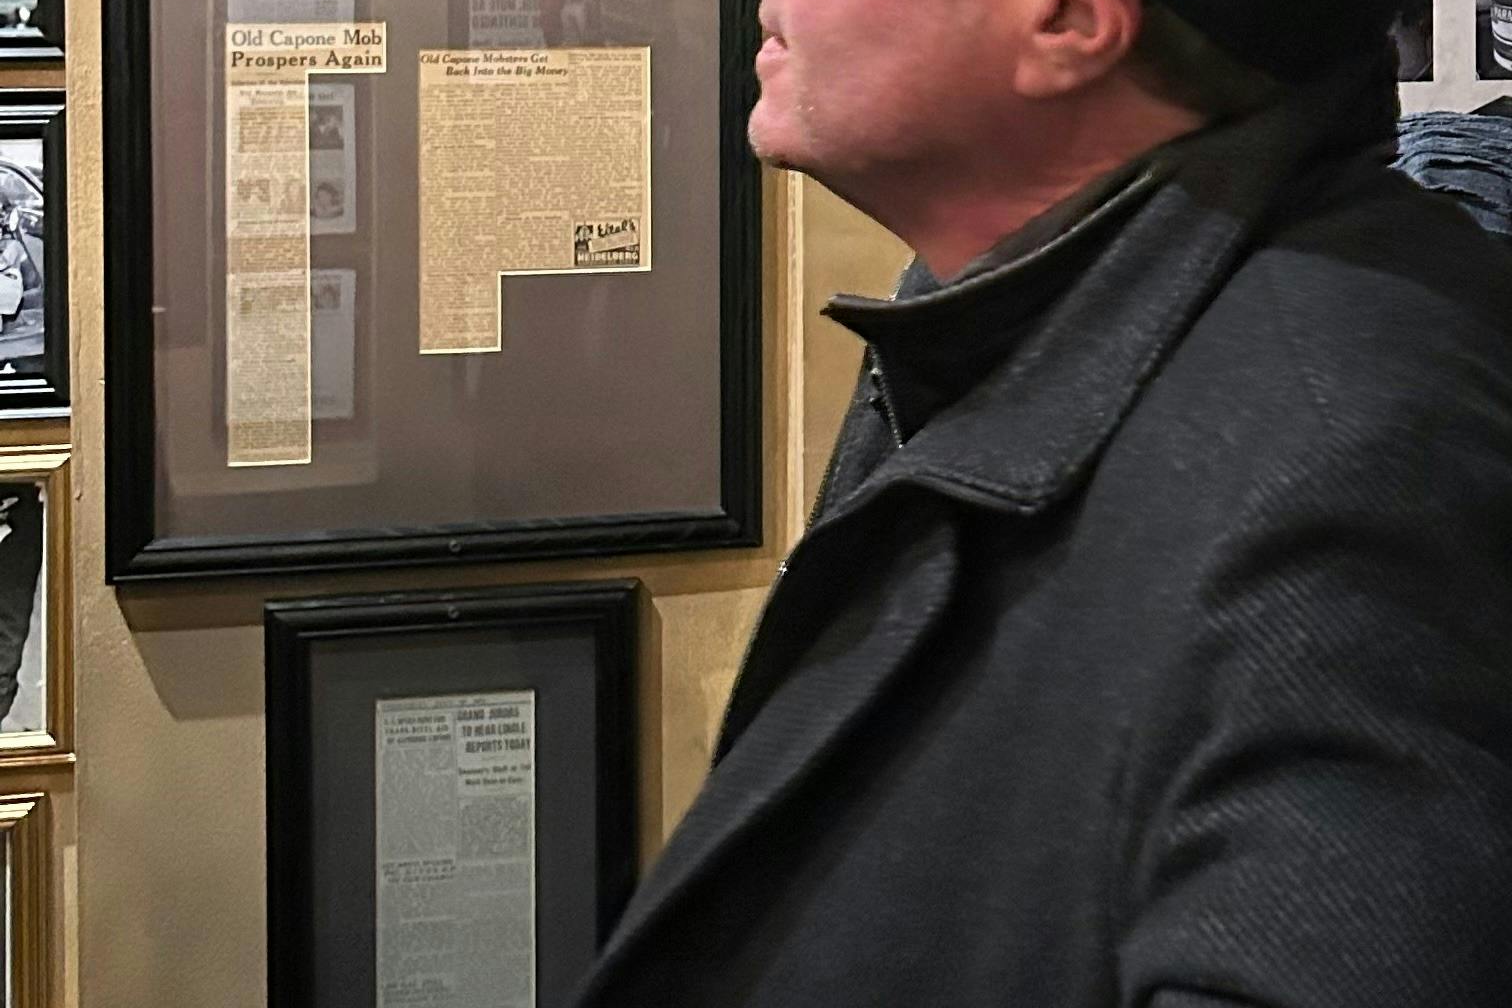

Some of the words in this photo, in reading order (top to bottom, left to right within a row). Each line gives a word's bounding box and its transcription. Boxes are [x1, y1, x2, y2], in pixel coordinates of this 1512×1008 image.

[231, 29, 262, 47] Old
[270, 30, 336, 49] Capone
[343, 29, 382, 45] Mob
[231, 51, 317, 70] Prospers
[325, 50, 382, 68] Again
[420, 54, 440, 64] Old
[483, 53, 528, 64] Mobsters
[530, 54, 548, 63] Get
[446, 66, 469, 76] Back
[497, 67, 512, 76] the
[515, 66, 532, 76] Big
